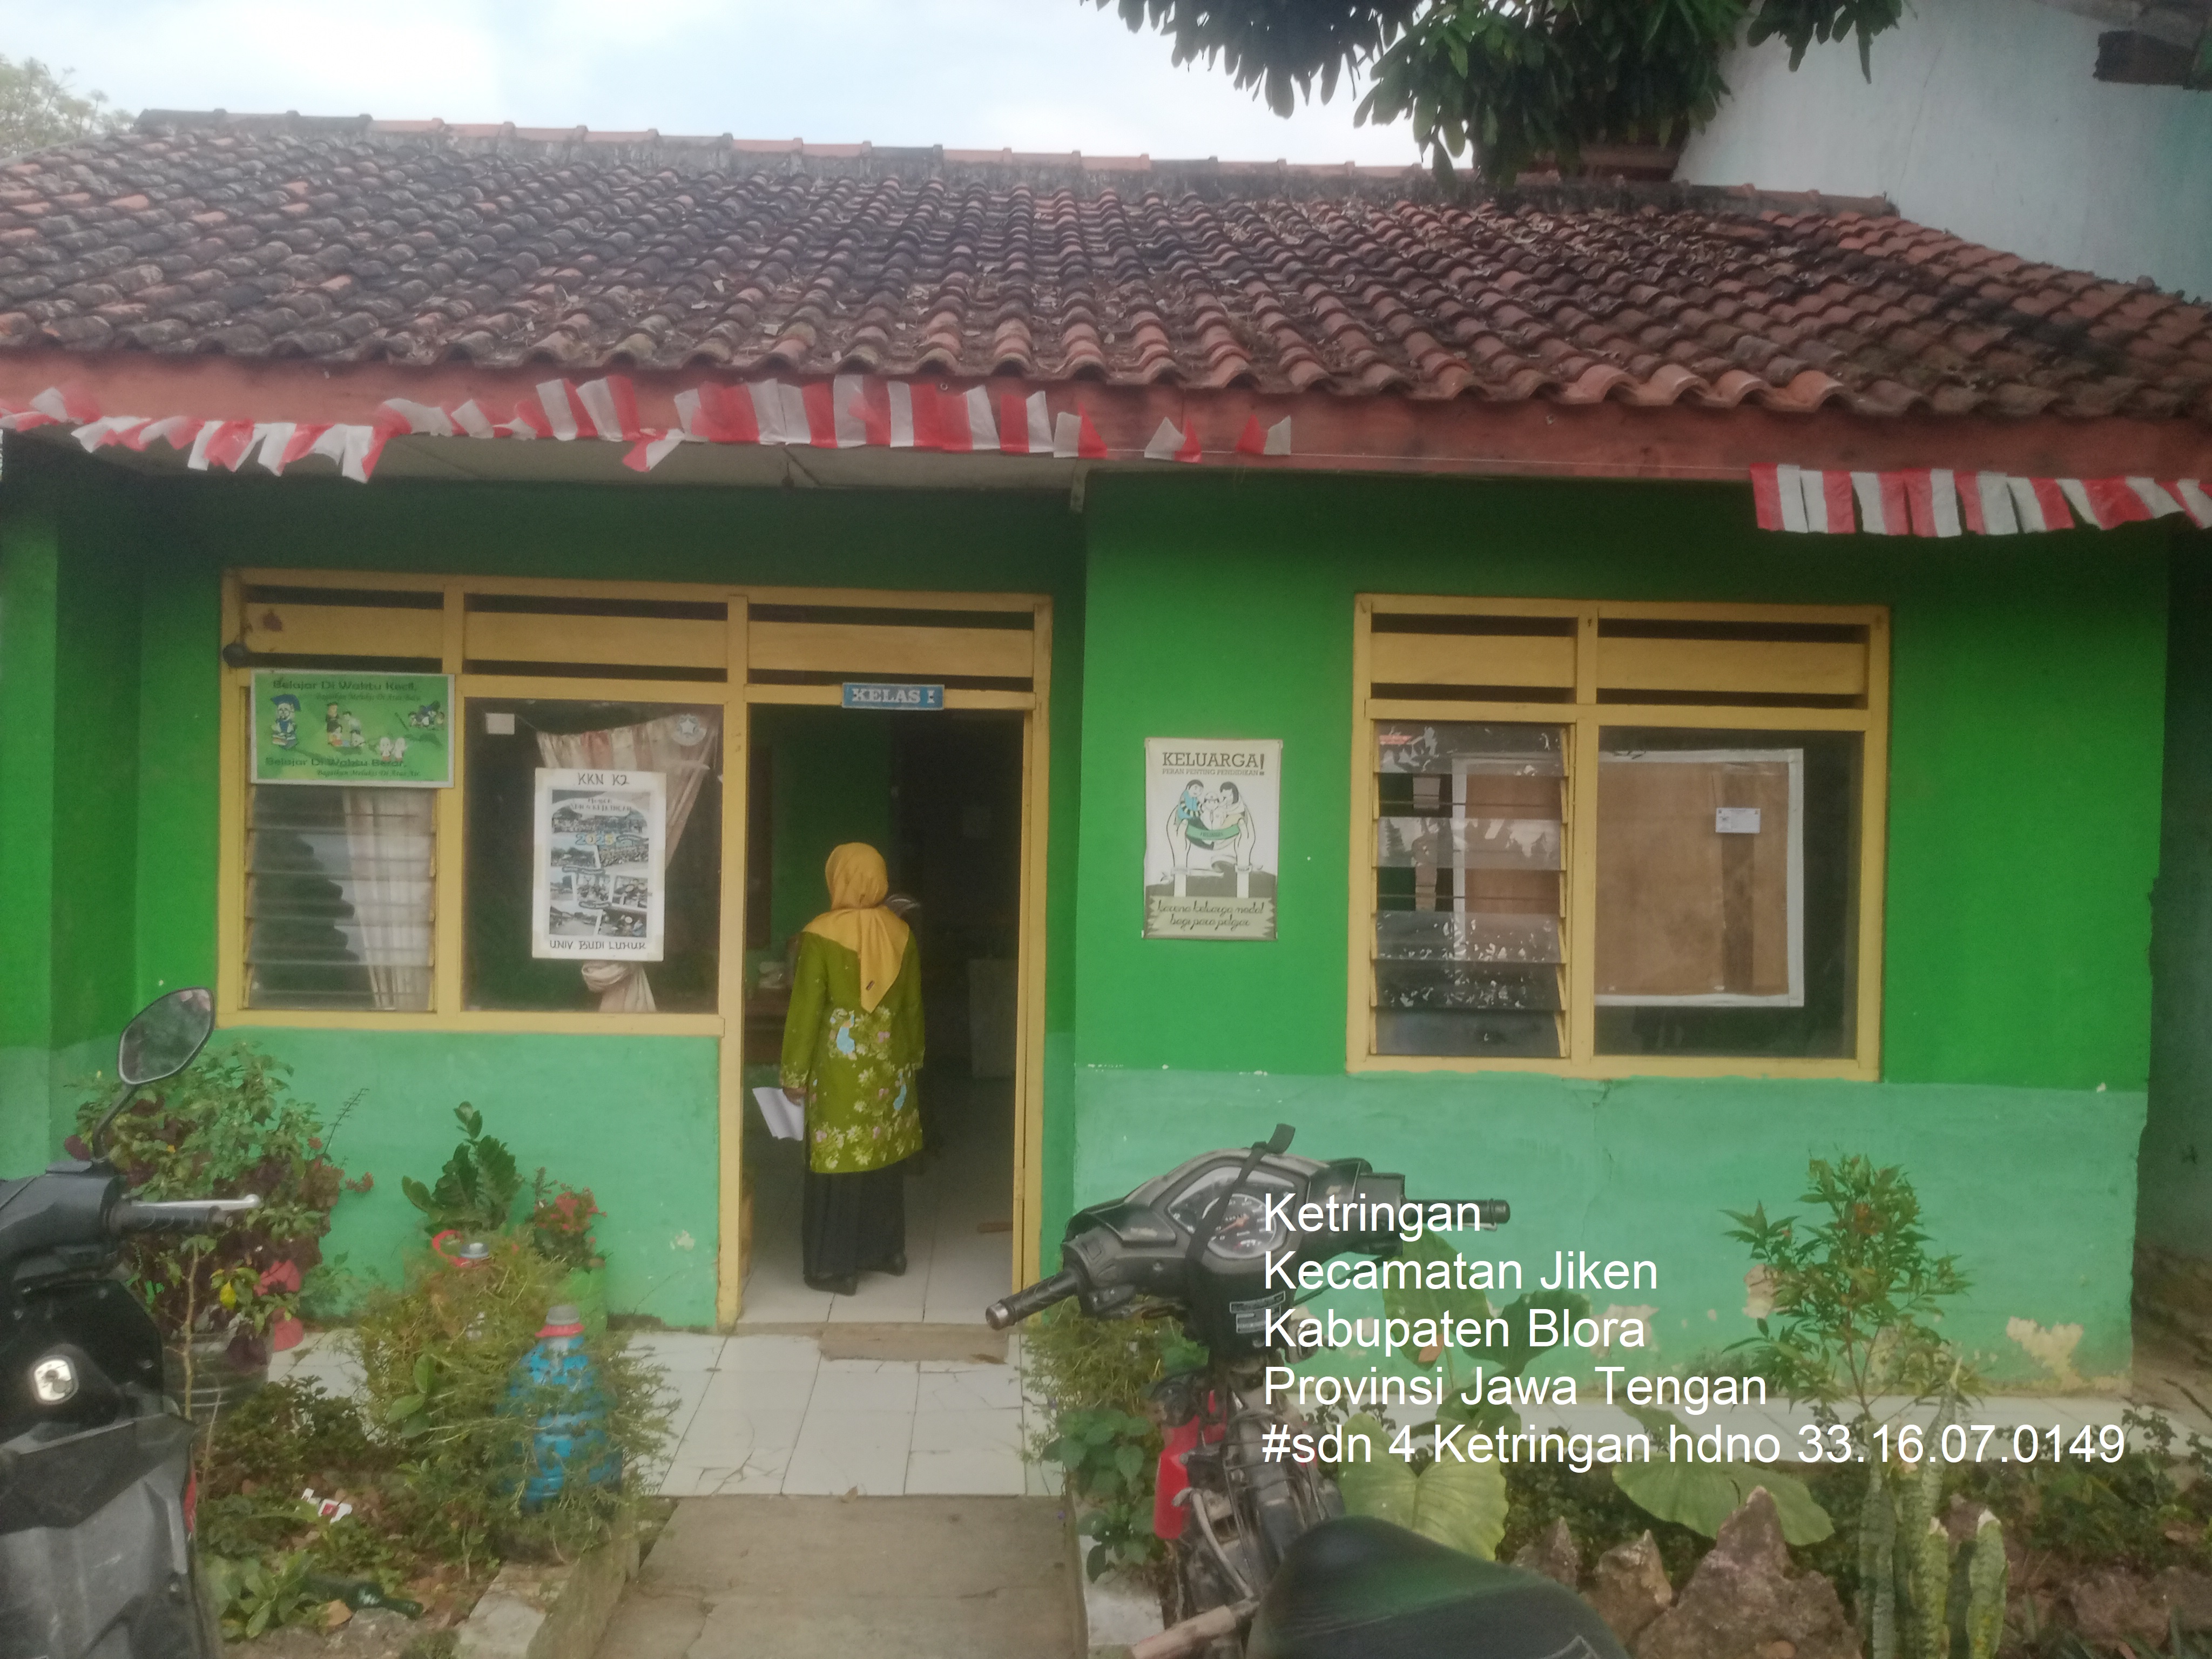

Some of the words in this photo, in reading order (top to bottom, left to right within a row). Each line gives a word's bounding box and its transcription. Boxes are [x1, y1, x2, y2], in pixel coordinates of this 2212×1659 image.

[273, 680, 317, 691] Belajar
[852, 689, 921, 703] KELAS
[927, 690, 935, 703] I
[578, 773, 604, 785] KKN
[612, 774, 630, 786] K2
[550, 940, 573, 949] UNIV
[579, 941, 604, 950] BUDI
